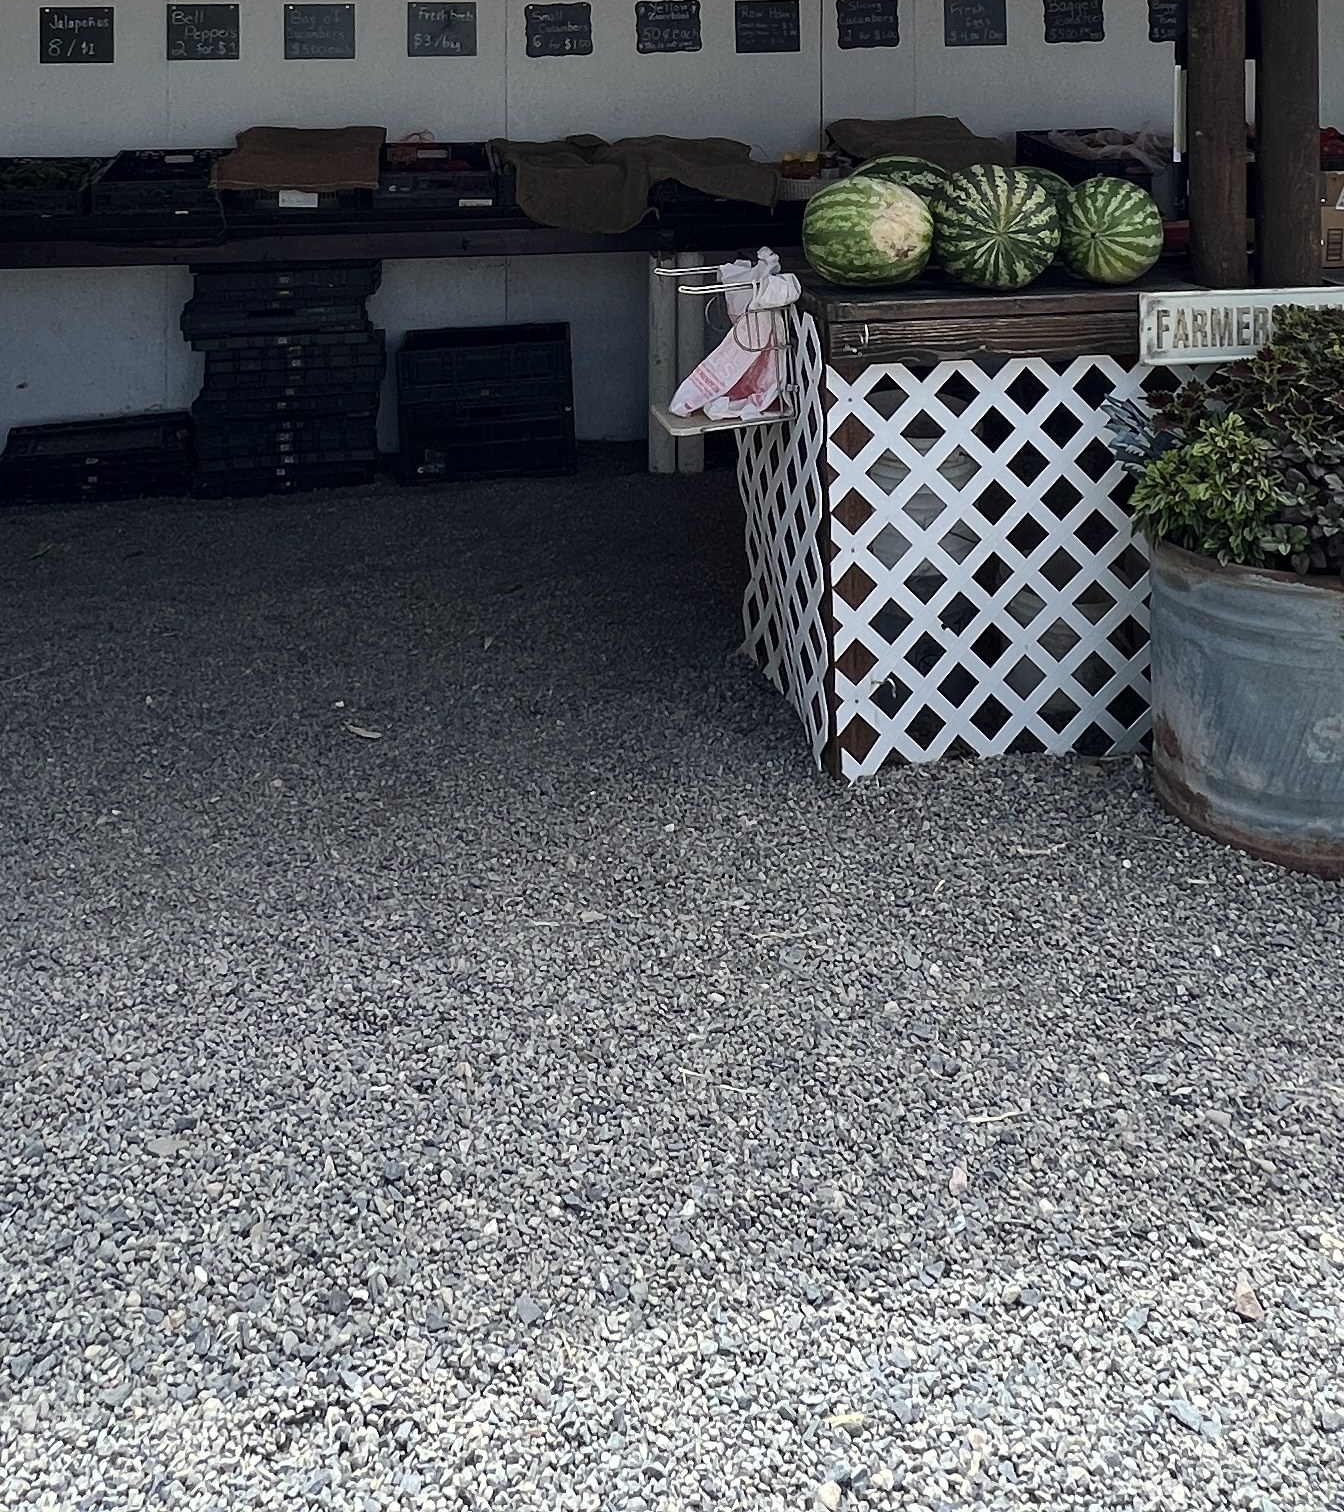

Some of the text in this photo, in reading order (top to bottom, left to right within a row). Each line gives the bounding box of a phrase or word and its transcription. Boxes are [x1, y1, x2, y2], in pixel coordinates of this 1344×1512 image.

[171, 9, 205, 25] Bell
[183, 25, 238, 44] Peppers
[171, 40, 188, 57] 2
[1155, 306, 1275, 350] FARMER
